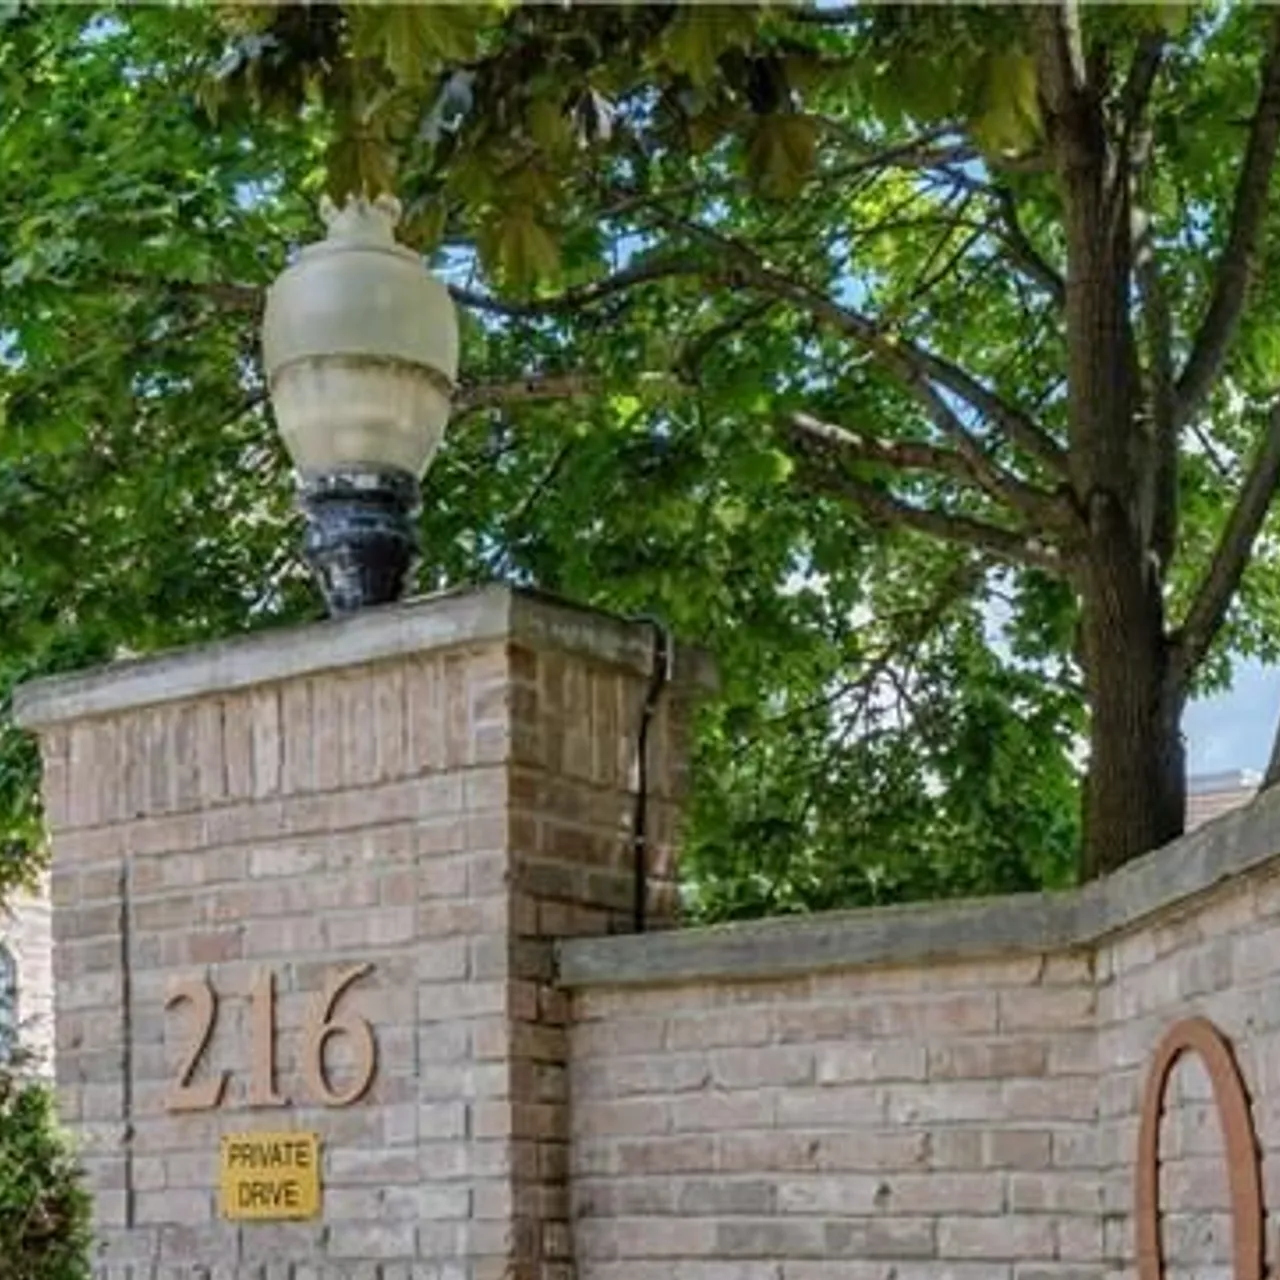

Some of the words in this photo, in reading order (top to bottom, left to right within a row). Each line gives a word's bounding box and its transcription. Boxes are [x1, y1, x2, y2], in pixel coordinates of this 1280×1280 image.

[164, 961, 381, 1112] 216
[227, 1142, 312, 1171] PRIVATE
[237, 1180, 300, 1208] DRIVE
